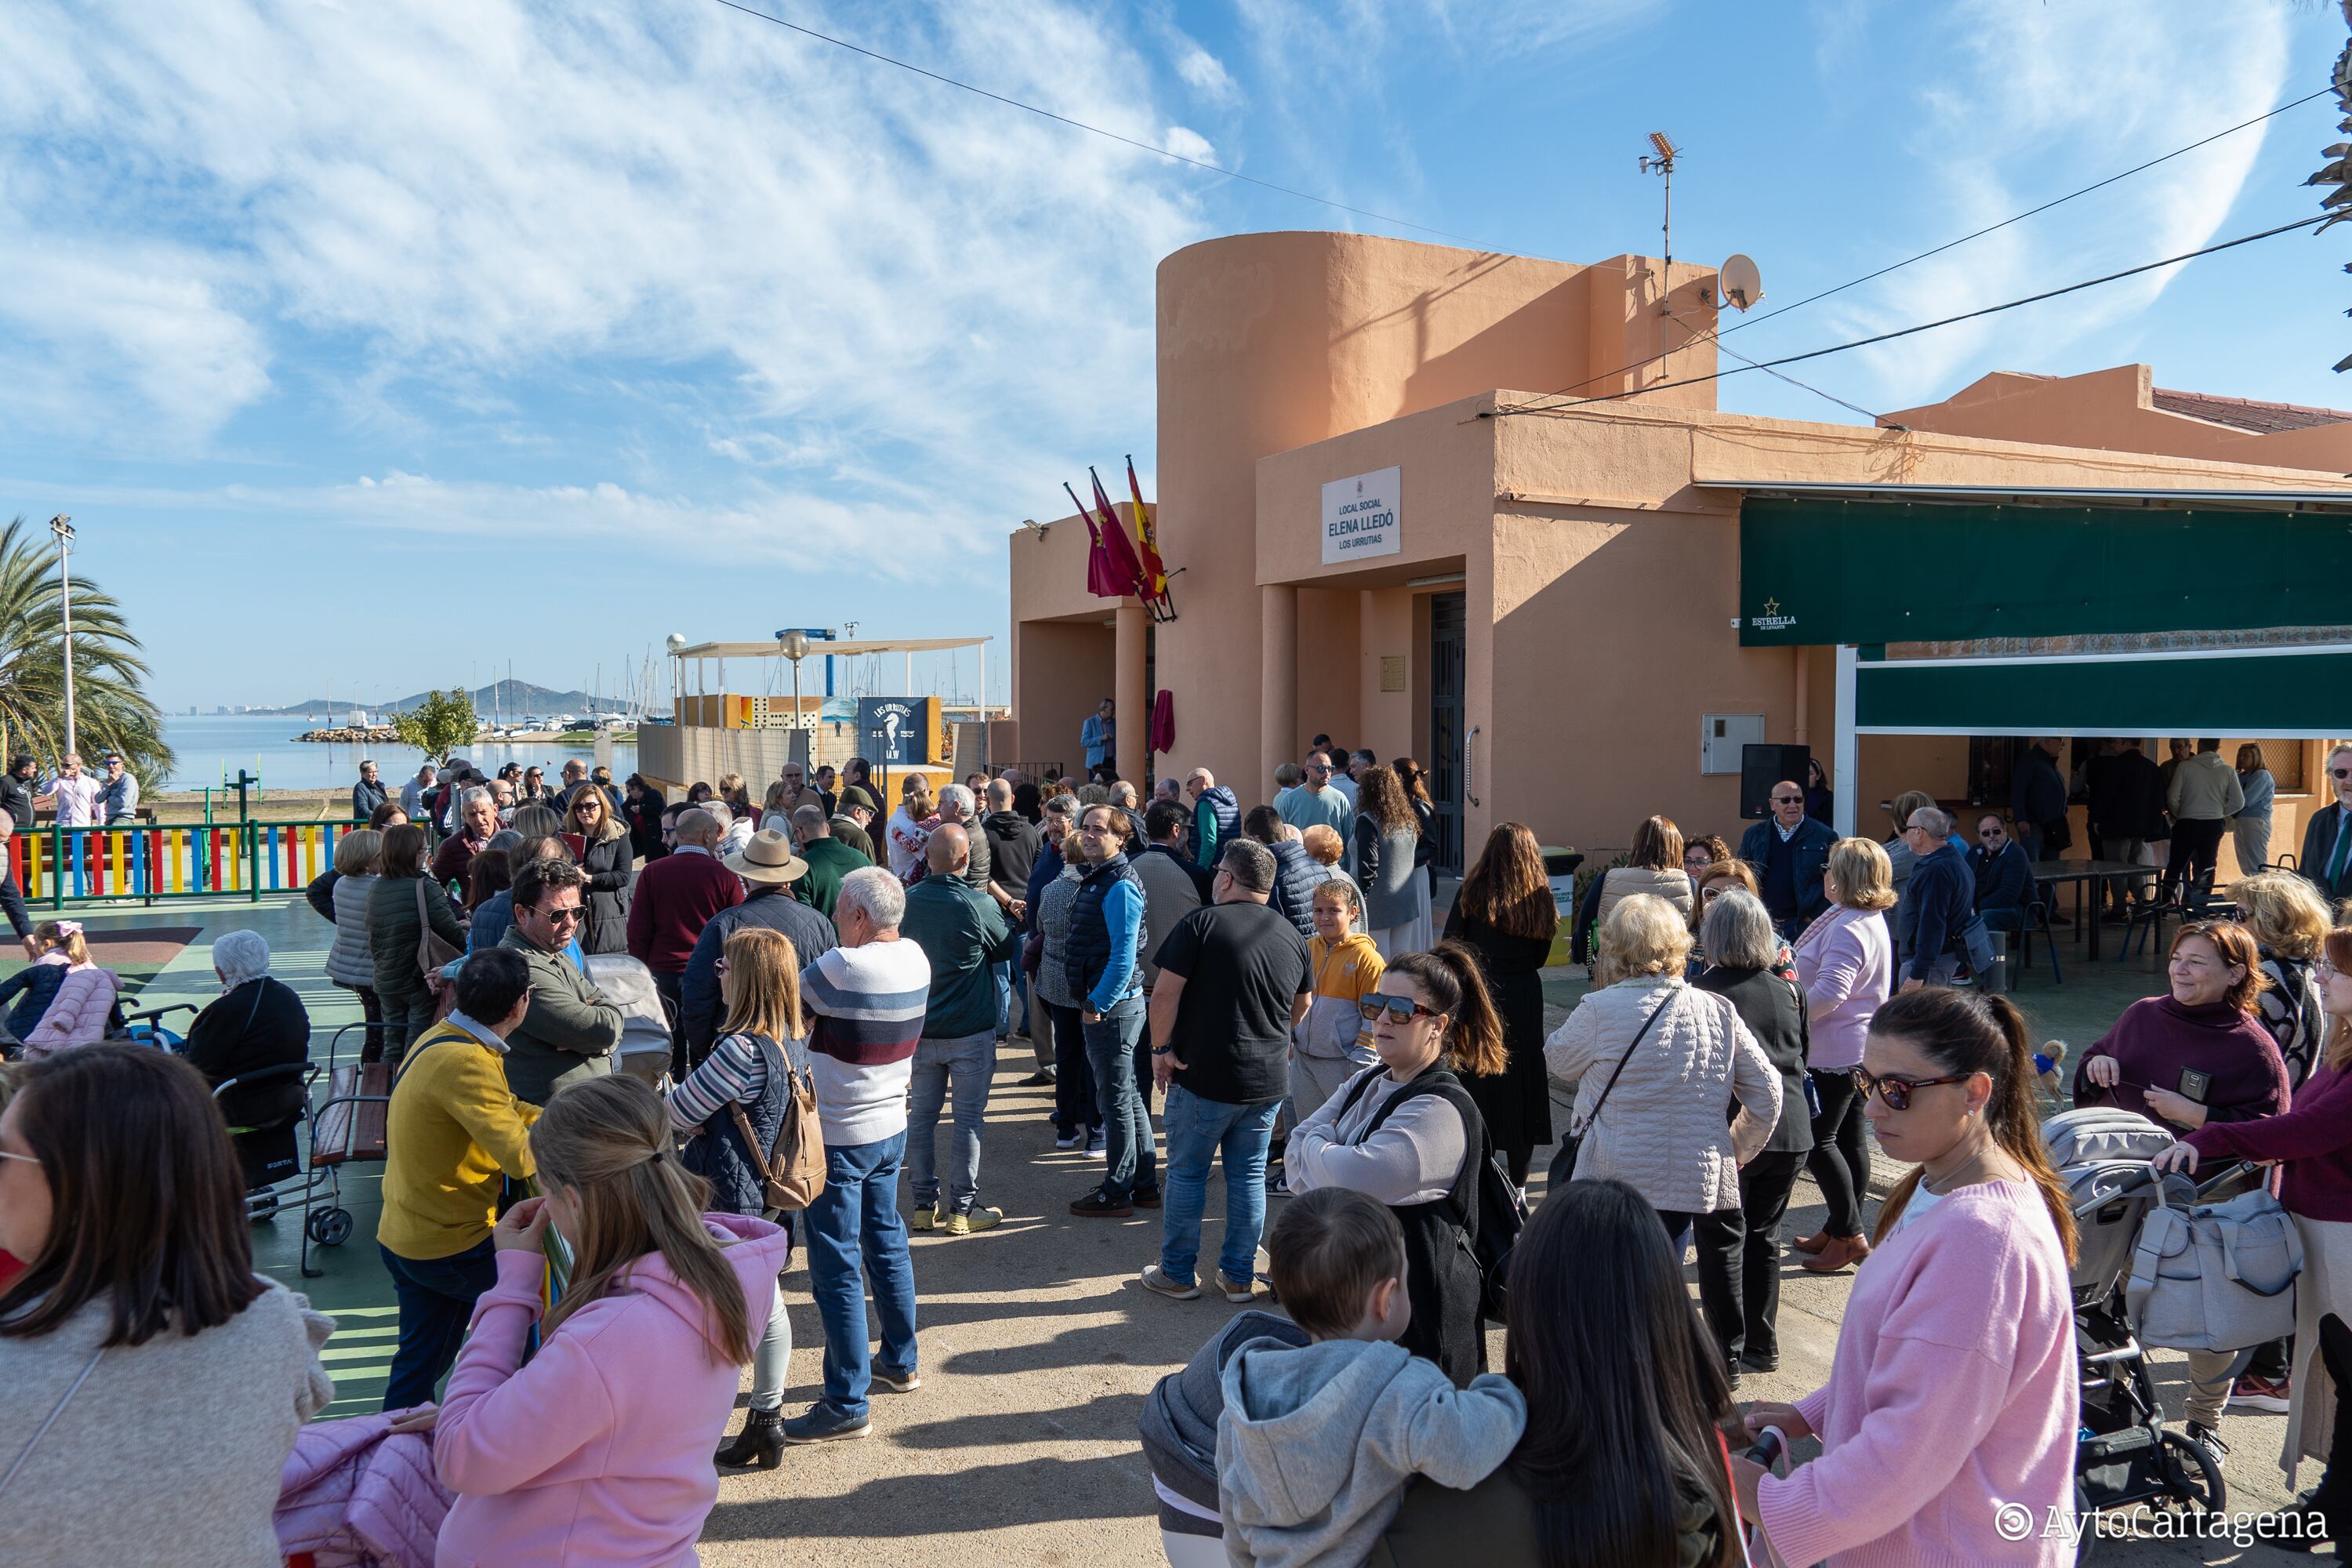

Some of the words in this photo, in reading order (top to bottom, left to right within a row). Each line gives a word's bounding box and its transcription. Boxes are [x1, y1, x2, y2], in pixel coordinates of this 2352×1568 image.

[1339, 503, 1359, 515] LOCAL
[1359, 498, 1381, 511] SOCIAL
[1329, 518, 1359, 537] ELENA
[1361, 509, 1393, 532] LLEDÓ
[1339, 539, 1351, 550] LOS
[1352, 534, 1382, 547] URRUTIAS
[1751, 615, 1797, 626] ESTRELLA
[873, 706, 886, 718] LOS
[884, 702, 912, 717] URRUTIAS
